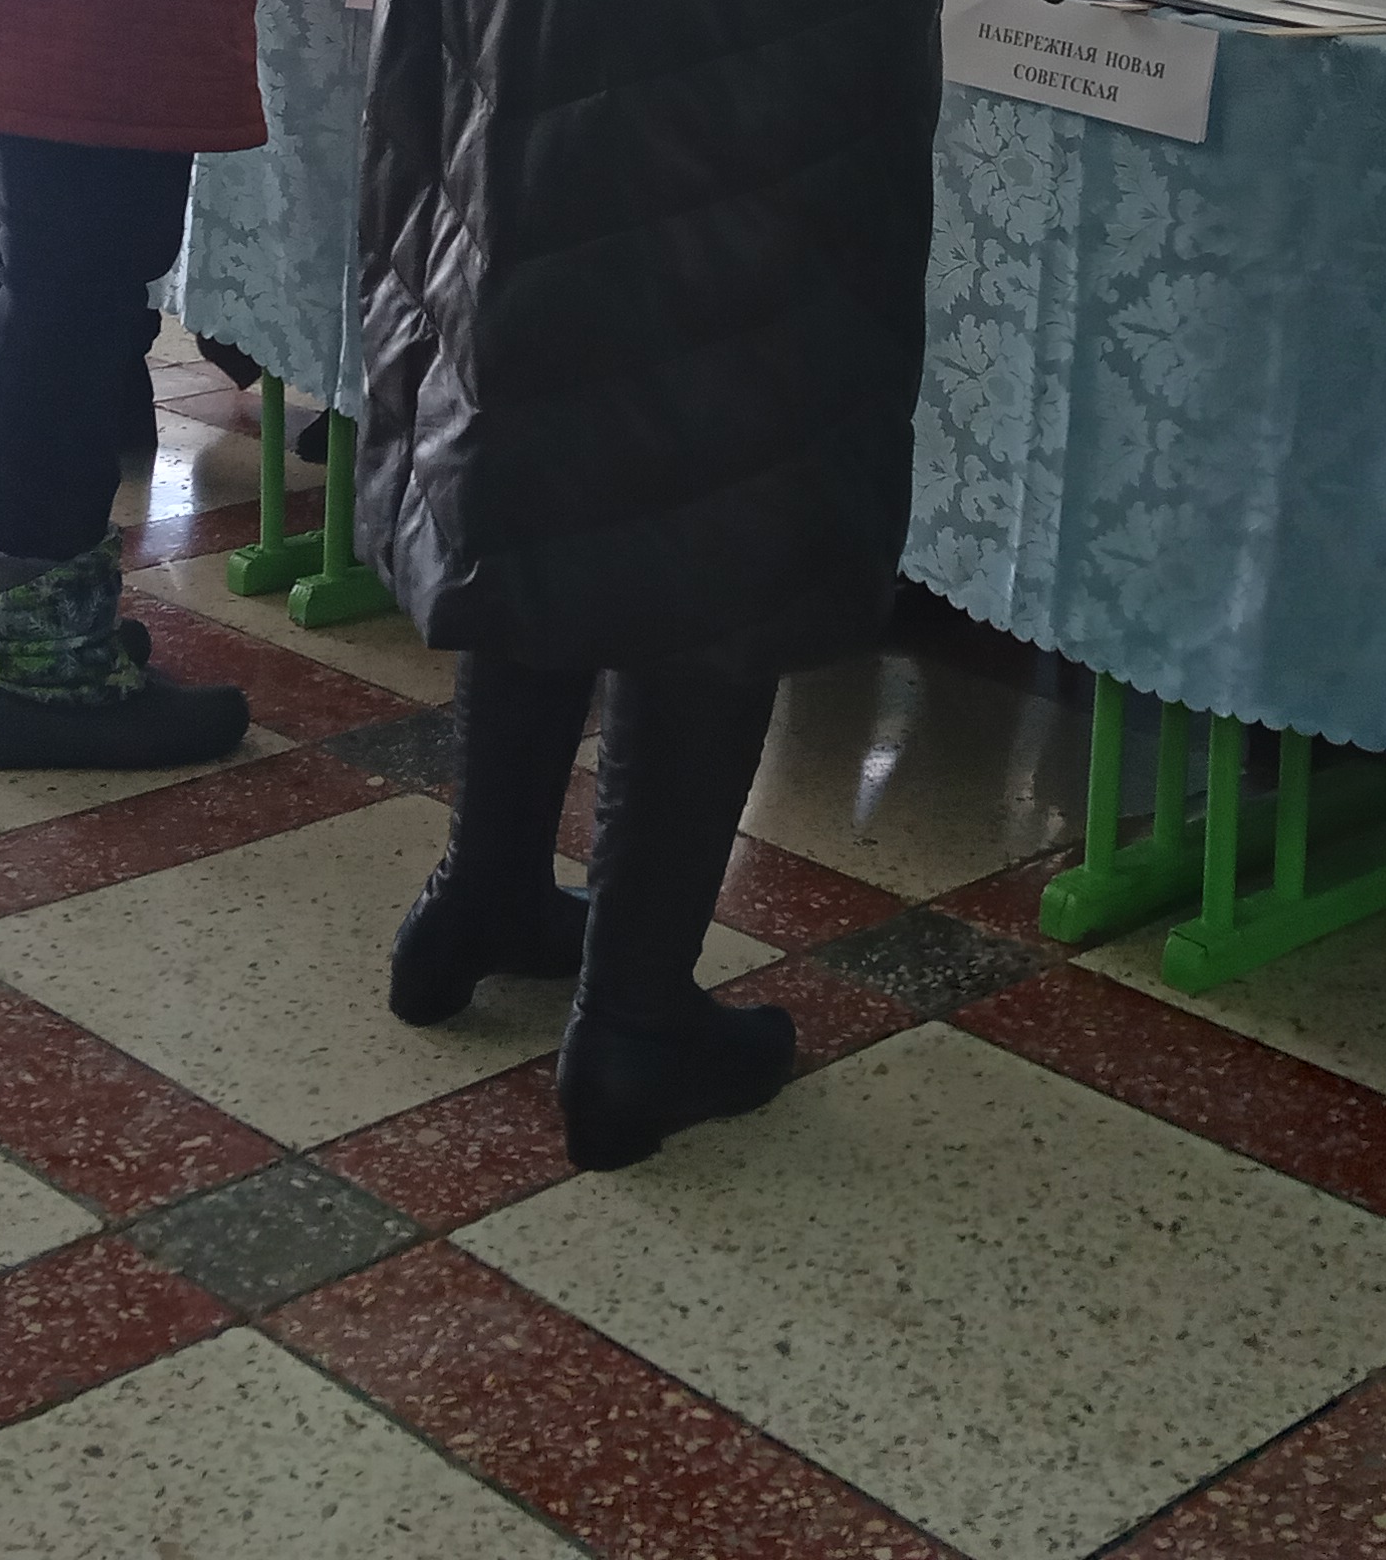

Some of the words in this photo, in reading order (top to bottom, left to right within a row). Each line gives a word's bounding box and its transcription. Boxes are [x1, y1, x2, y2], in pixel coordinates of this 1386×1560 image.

[978, 23, 1098, 63] НАБЕРЕЖНАЯ
[1105, 50, 1165, 79] НОВАЯ
[1013, 63, 1119, 102] СОВЕТСКАЯ
